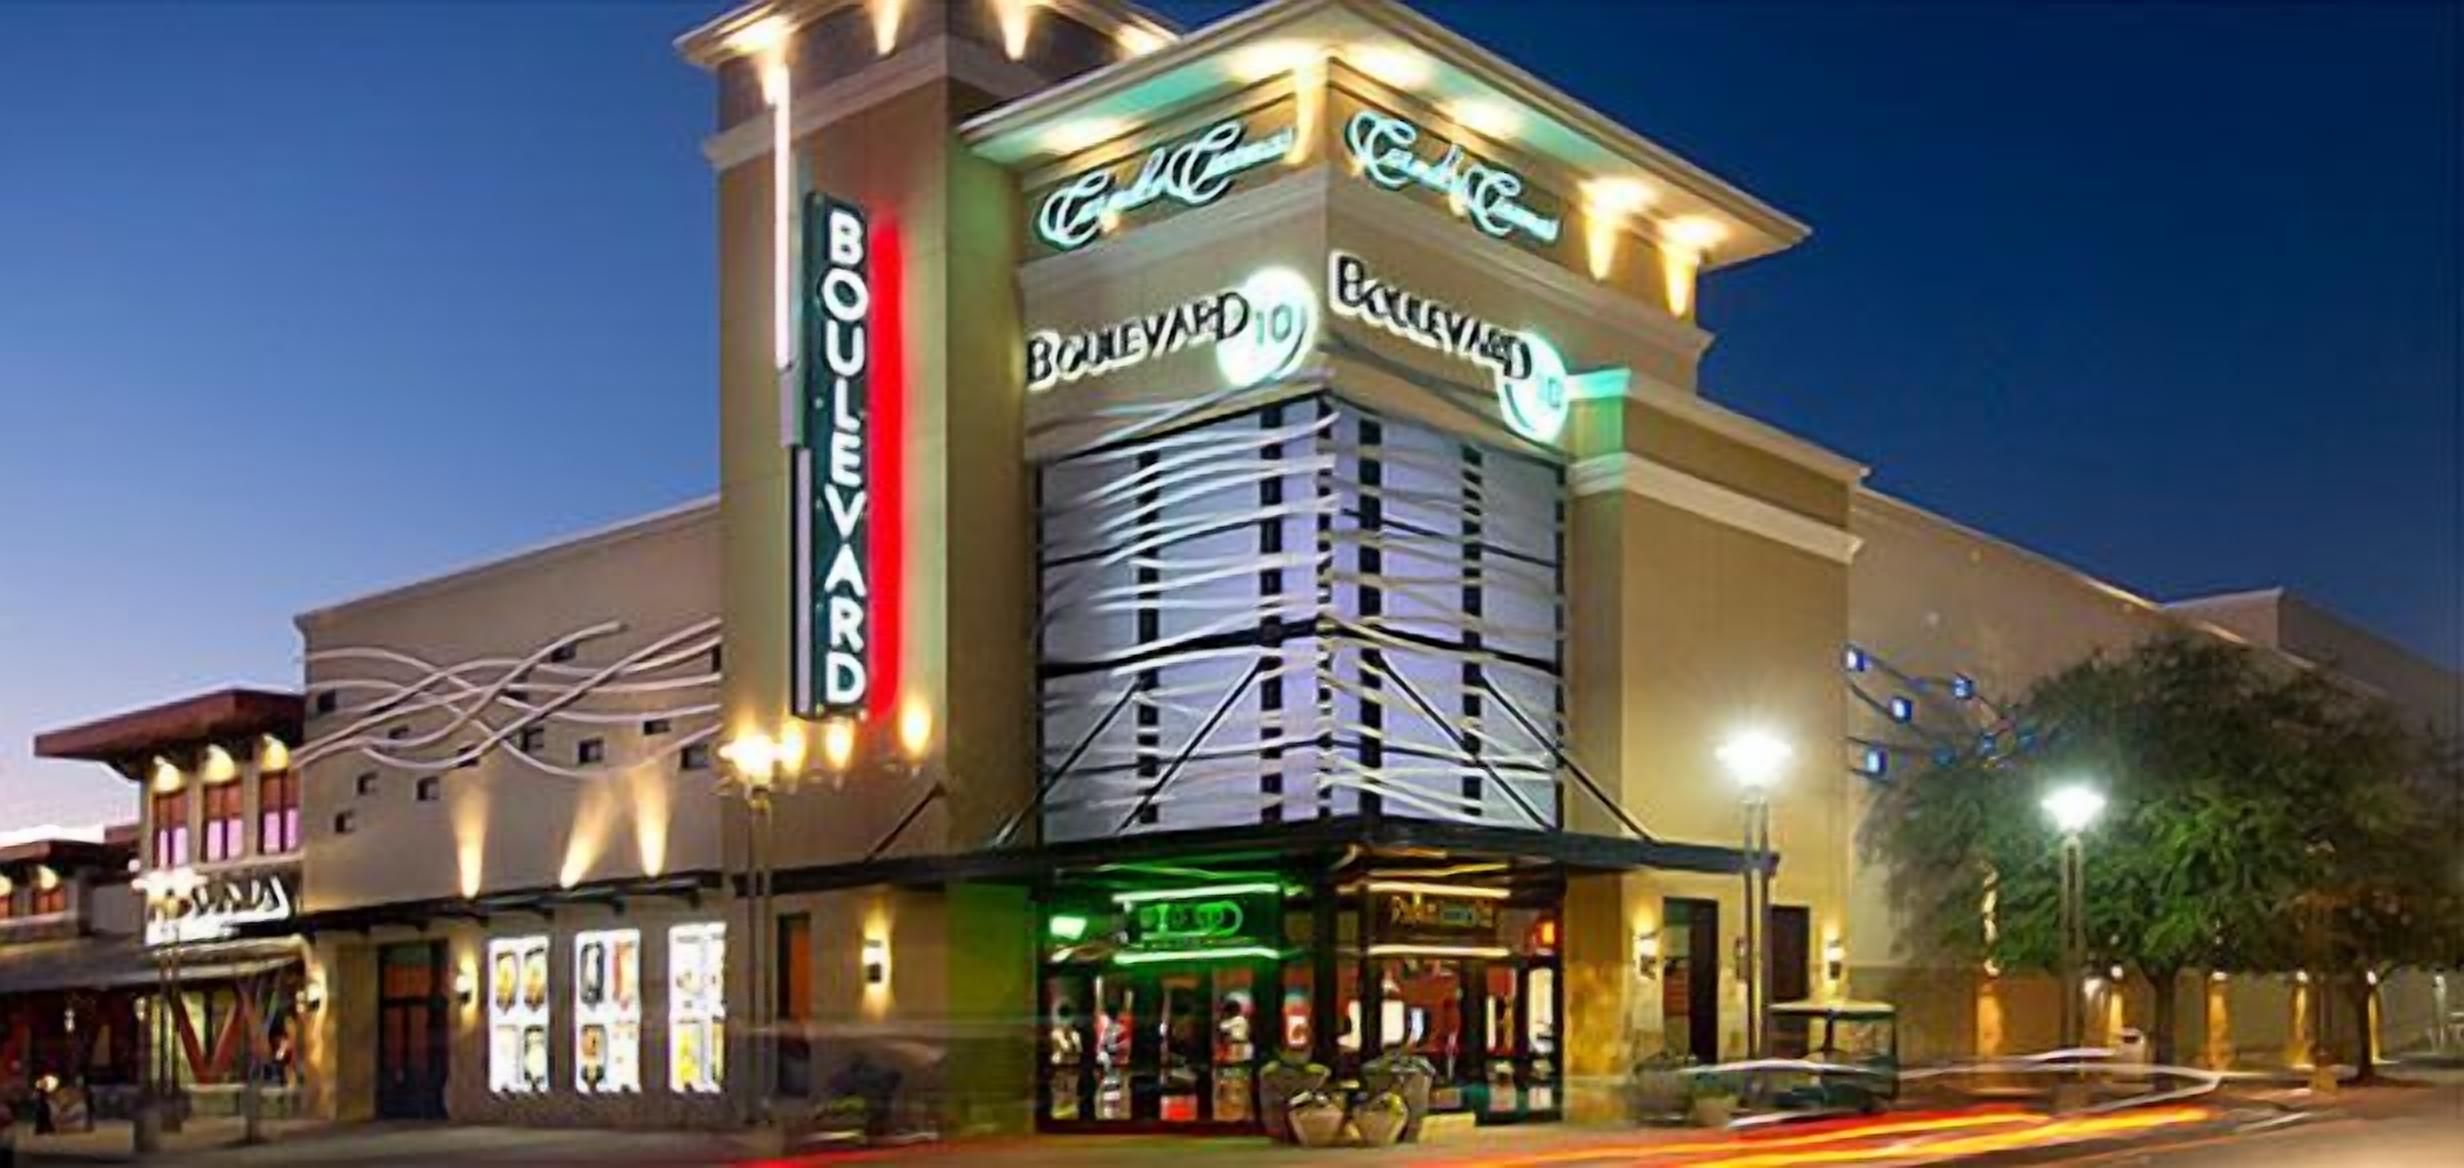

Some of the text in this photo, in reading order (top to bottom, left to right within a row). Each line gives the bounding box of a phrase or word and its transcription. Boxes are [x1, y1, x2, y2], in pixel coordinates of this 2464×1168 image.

[1026, 291, 1292, 384] BOULEVARD 10
[1336, 254, 1533, 380] BOULEVARD
[821, 209, 869, 705] BOULEVARD
